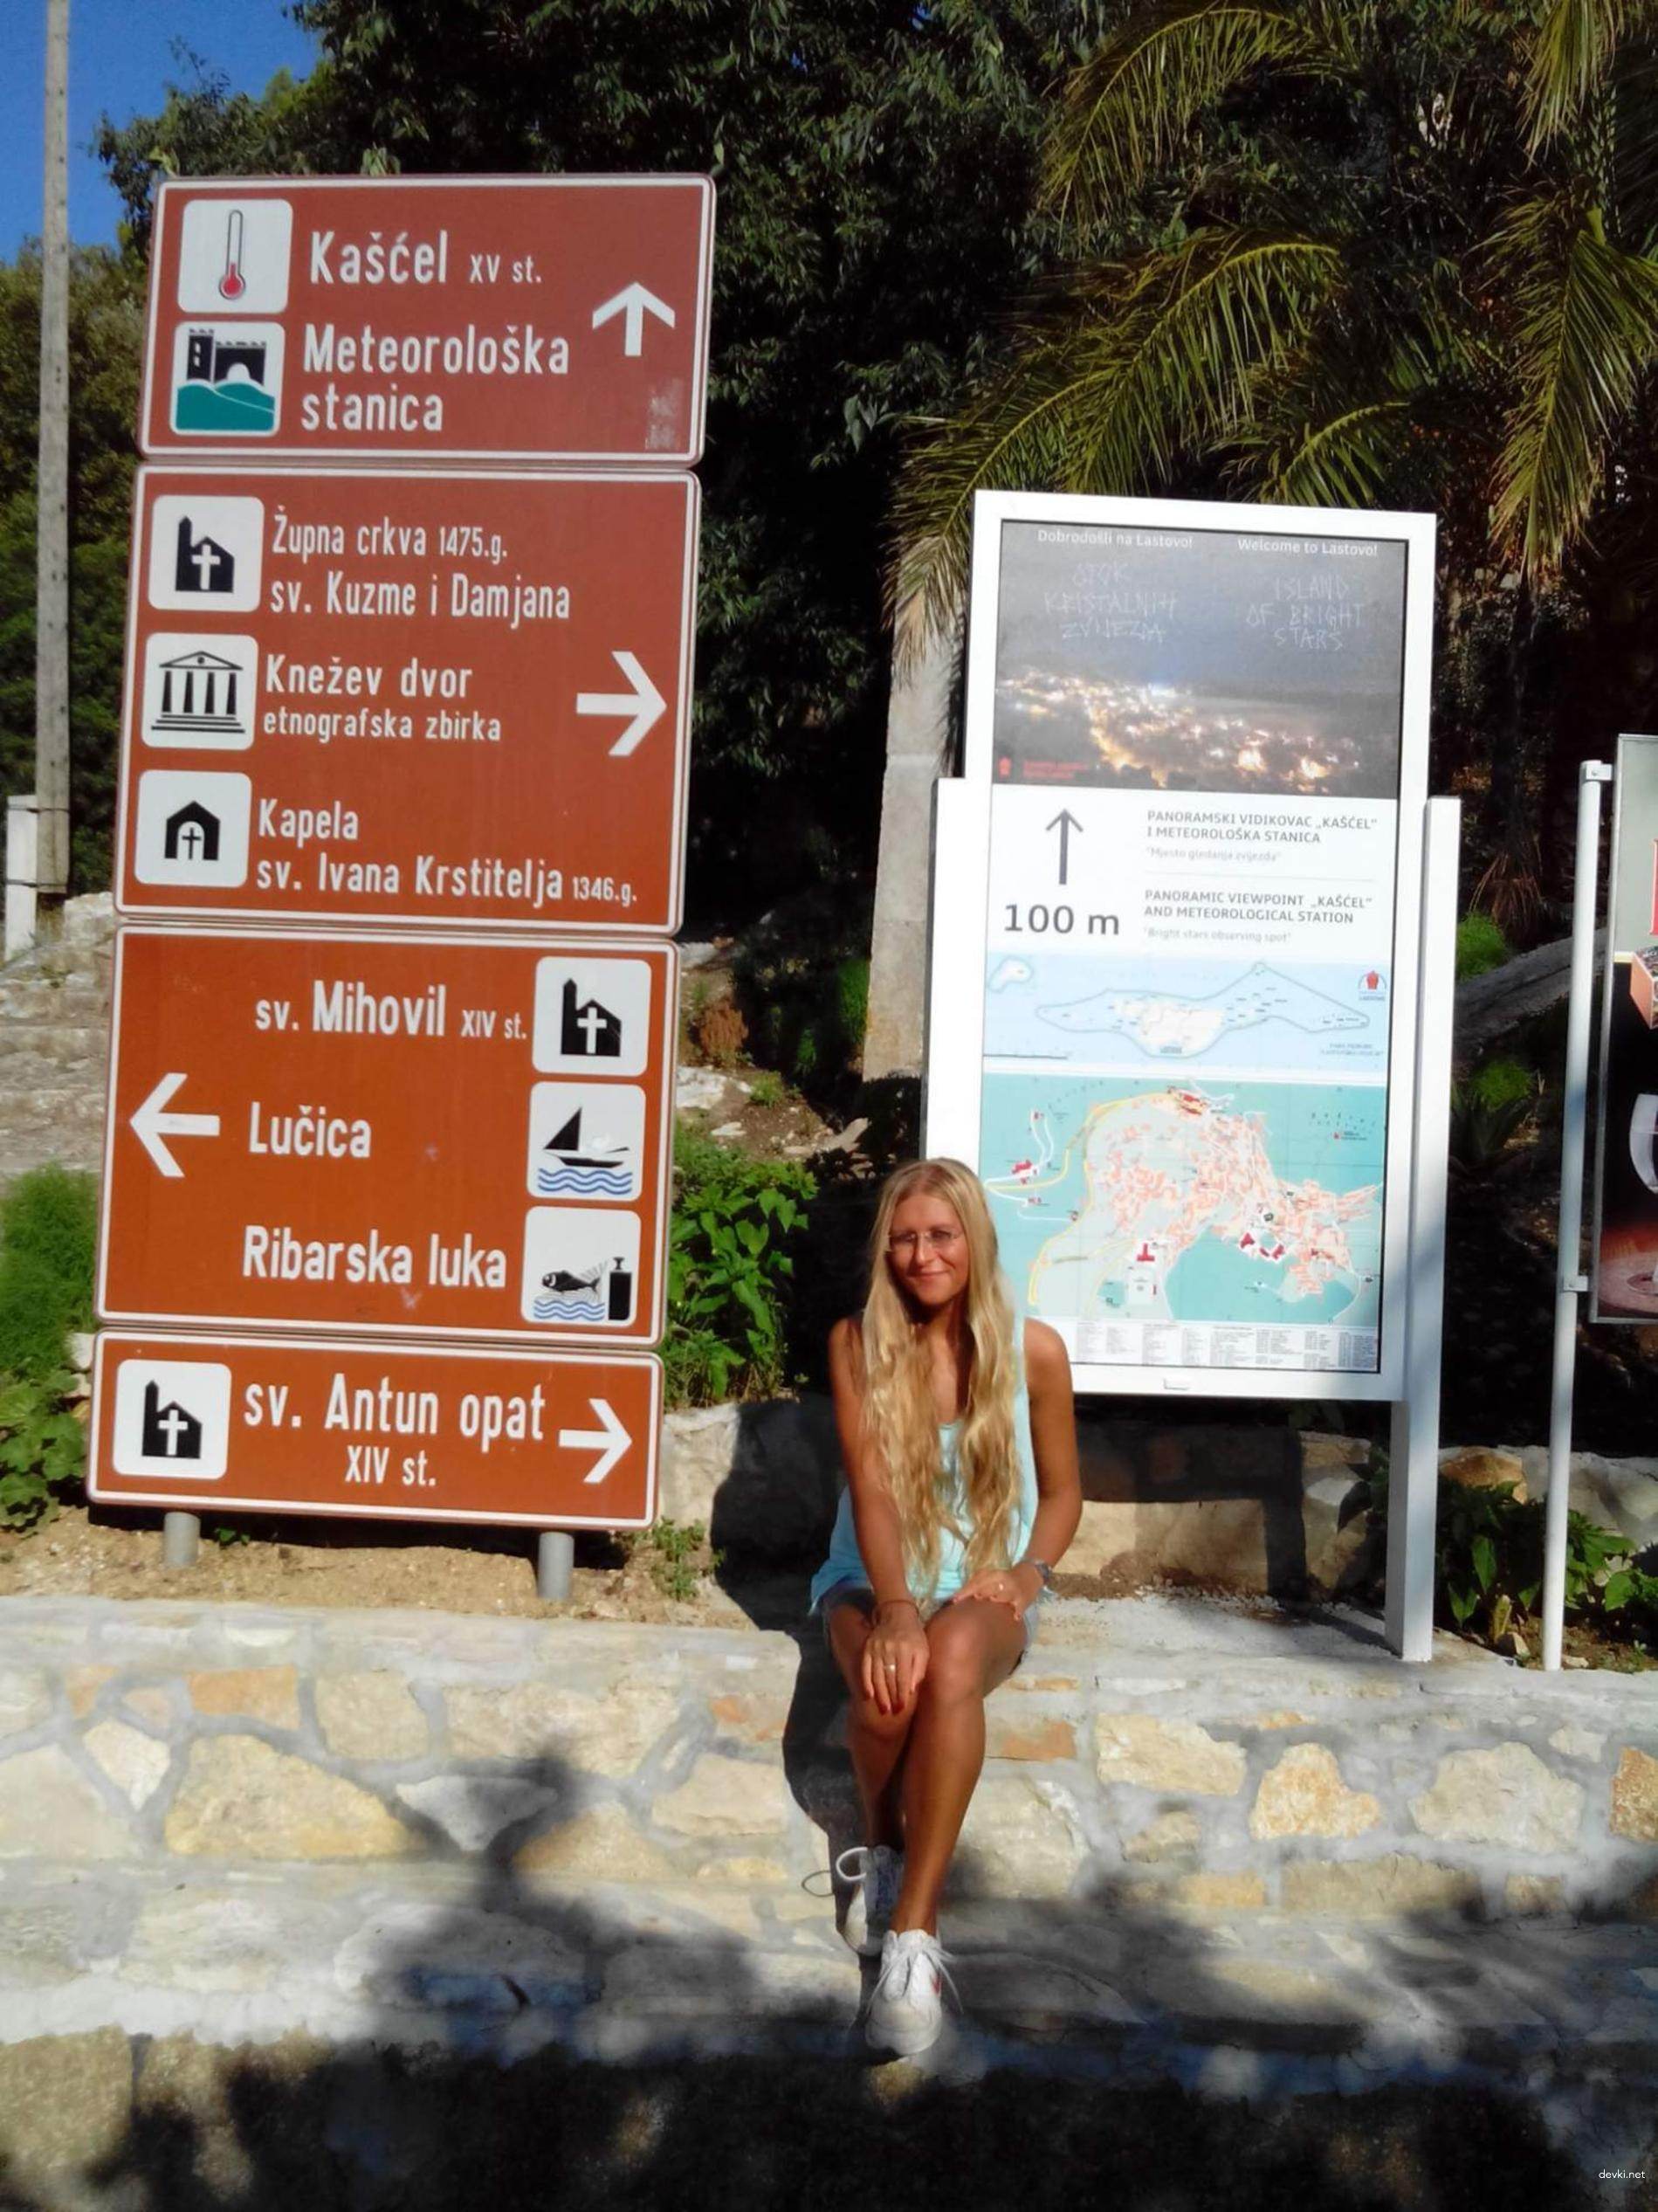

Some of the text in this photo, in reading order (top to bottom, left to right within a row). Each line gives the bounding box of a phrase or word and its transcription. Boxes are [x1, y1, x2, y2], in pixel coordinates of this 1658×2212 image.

[310, 230, 542, 285] Kašćel XV st.
[302, 323, 570, 375] Meteorološka
[301, 382, 443, 432] stanica
[272, 504, 345, 563] Župna
[357, 518, 426, 555] crkva
[1117, 535, 1132, 545] na
[1136, 534, 1194, 548] Lastovo!
[1238, 538, 1378, 556] Welcome to Lastovo!
[271, 571, 570, 629] sv. Kuzme i Damjana
[1276, 574, 1349, 600] ISLAND
[1246, 603, 1275, 627] OF
[1274, 627, 1344, 651] STARS
[265, 653, 473, 698] Knežev dvor
[264, 707, 501, 744] etnografska zbirka
[258, 799, 359, 848] Kapela
[1147, 810, 1235, 824] PANORAMSKI
[1239, 814, 1312, 828] VIDIKOVAC
[1147, 826, 1321, 843] I METEOROLOŠKA STANICA
[257, 858, 301, 892] sv.
[319, 852, 399, 893] Ivana
[416, 856, 562, 908] Krstitelja
[1145, 889, 1225, 903] PANORAMIC
[1228, 892, 1304, 906] VIEWPOINT
[1004, 903, 1120, 935] 100 m
[1144, 906, 1353, 924] AND METEOROLOGICAL STATION
[1183, 928, 1208, 940] stars
[255, 981, 527, 1040] sv. Mihovil XIV st.
[249, 1102, 371, 1158] Lučica
[243, 1225, 506, 1288] Ribarska luka
[244, 1373, 546, 1452] sv. Antun opat
[345, 1446, 436, 1486] XIV st.
